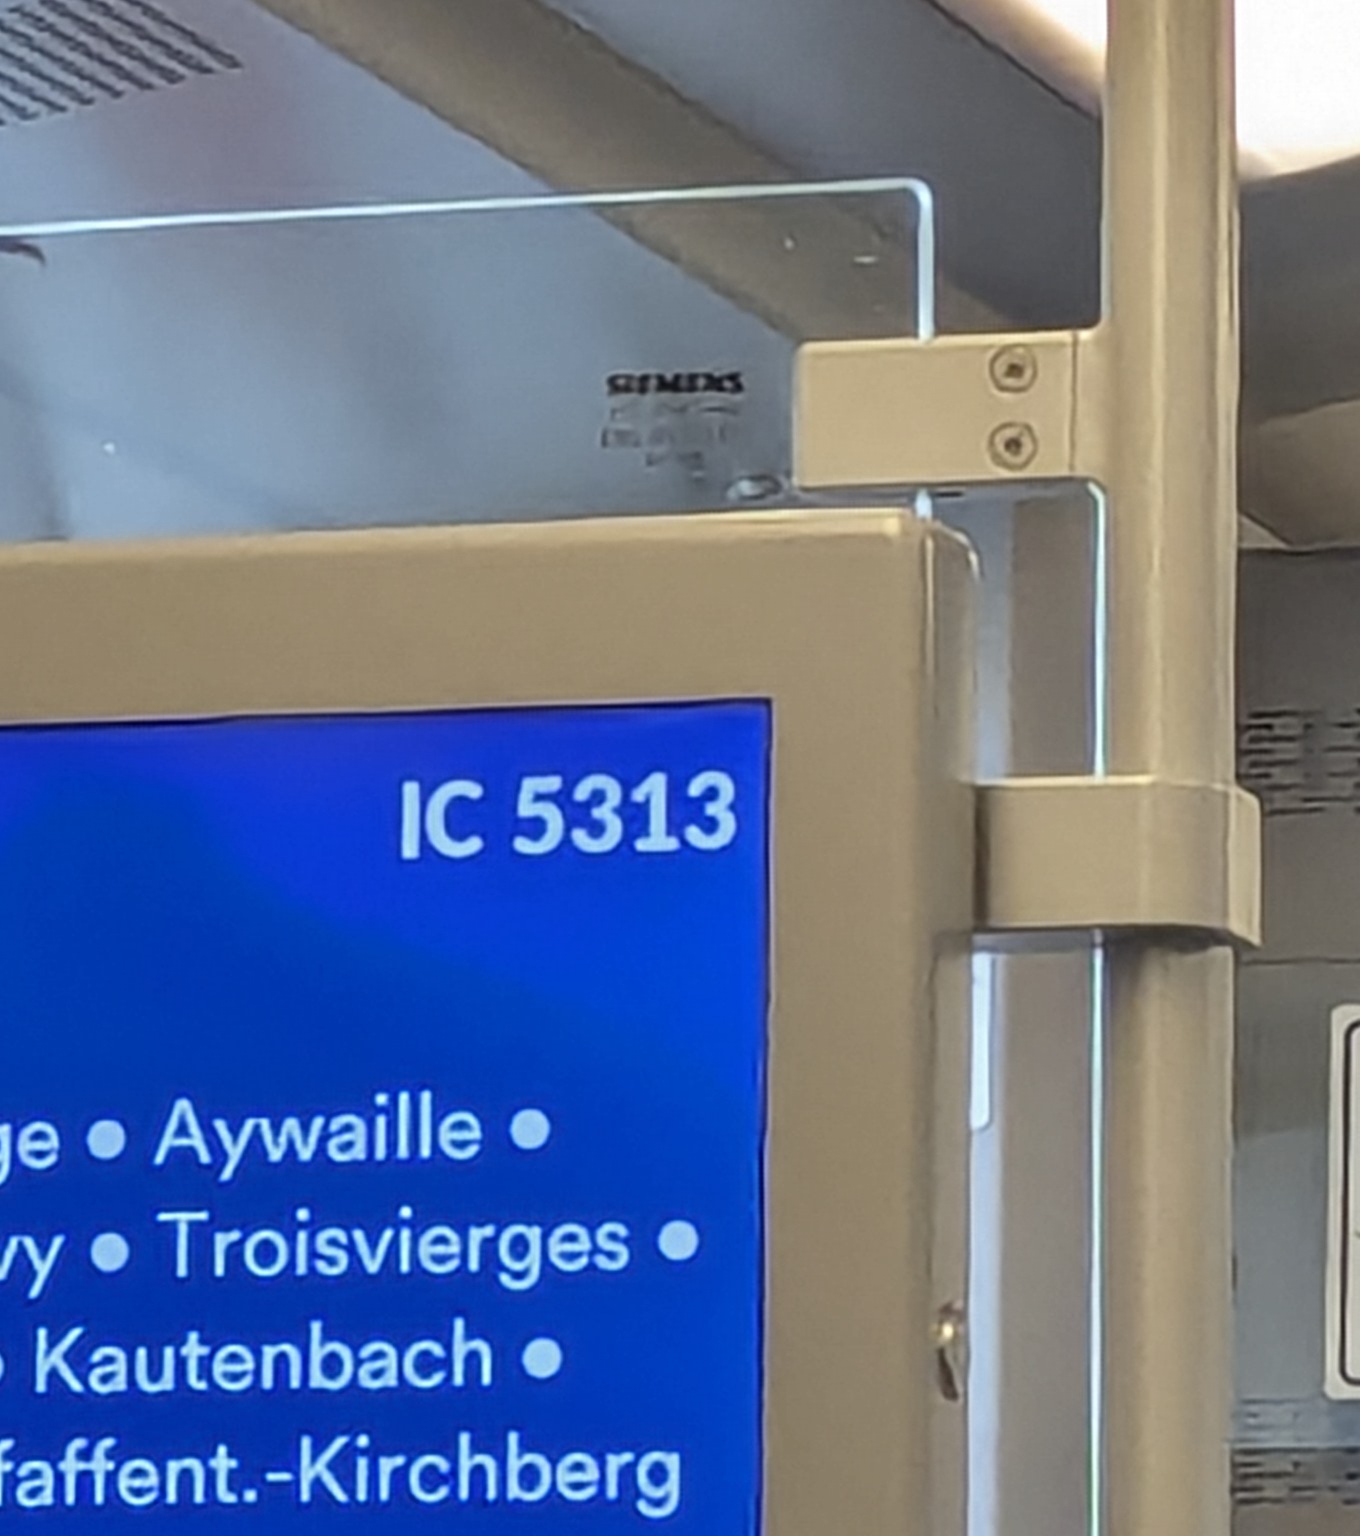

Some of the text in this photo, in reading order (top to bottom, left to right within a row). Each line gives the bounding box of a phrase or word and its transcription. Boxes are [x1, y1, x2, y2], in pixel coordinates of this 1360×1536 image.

[400, 770, 737, 860] IC 5313
[154, 1089, 482, 1182] Aywaille
[156, 1205, 630, 1291] Troisvierges
[35, 1317, 493, 1397] Kautenbach
